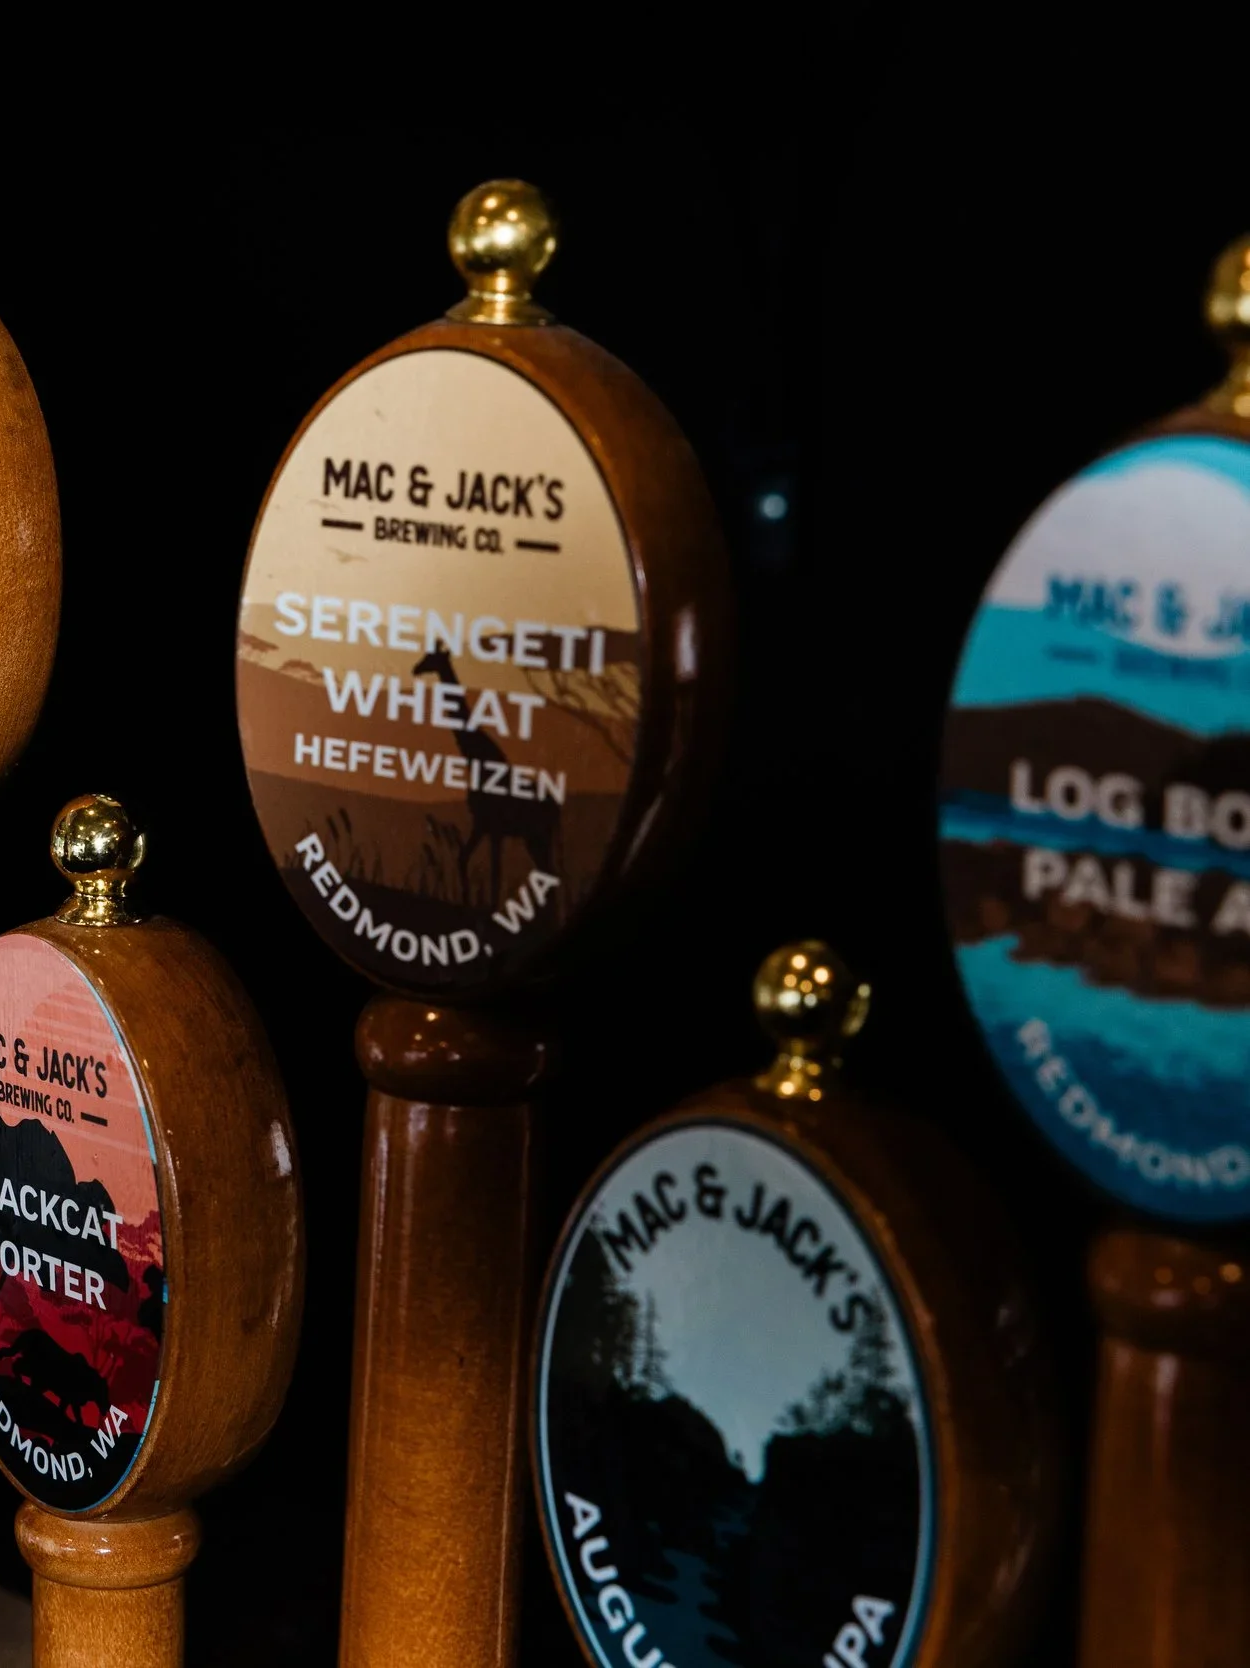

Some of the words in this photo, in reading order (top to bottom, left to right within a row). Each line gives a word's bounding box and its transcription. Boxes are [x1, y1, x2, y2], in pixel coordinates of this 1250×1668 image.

[322, 457, 394, 503] MAC
[407, 465, 434, 507] &
[445, 471, 566, 521] JACK'S
[373, 517, 467, 550] BREWING
[474, 526, 505, 555] CO.
[274, 591, 606, 677] SERENGETI
[322, 667, 546, 741] WHEAT
[293, 732, 567, 804] HEFEWEIZEN
[1010, 758, 1145, 830] LOG
[294, 833, 494, 967] REDMOND,
[493, 868, 561, 935] WA
[1021, 848, 1197, 929] PALE
[14, 1038, 29, 1077] &
[36, 1046, 107, 1098] JACK'S
[56, 1098, 75, 1123] CO.
[602, 1171, 687, 1272] MAC
[692, 1162, 728, 1219] &
[734, 1181, 872, 1333] JACK'S
[91, 1403, 130, 1460] WA
[564, 1491, 677, 1668] AUGU
